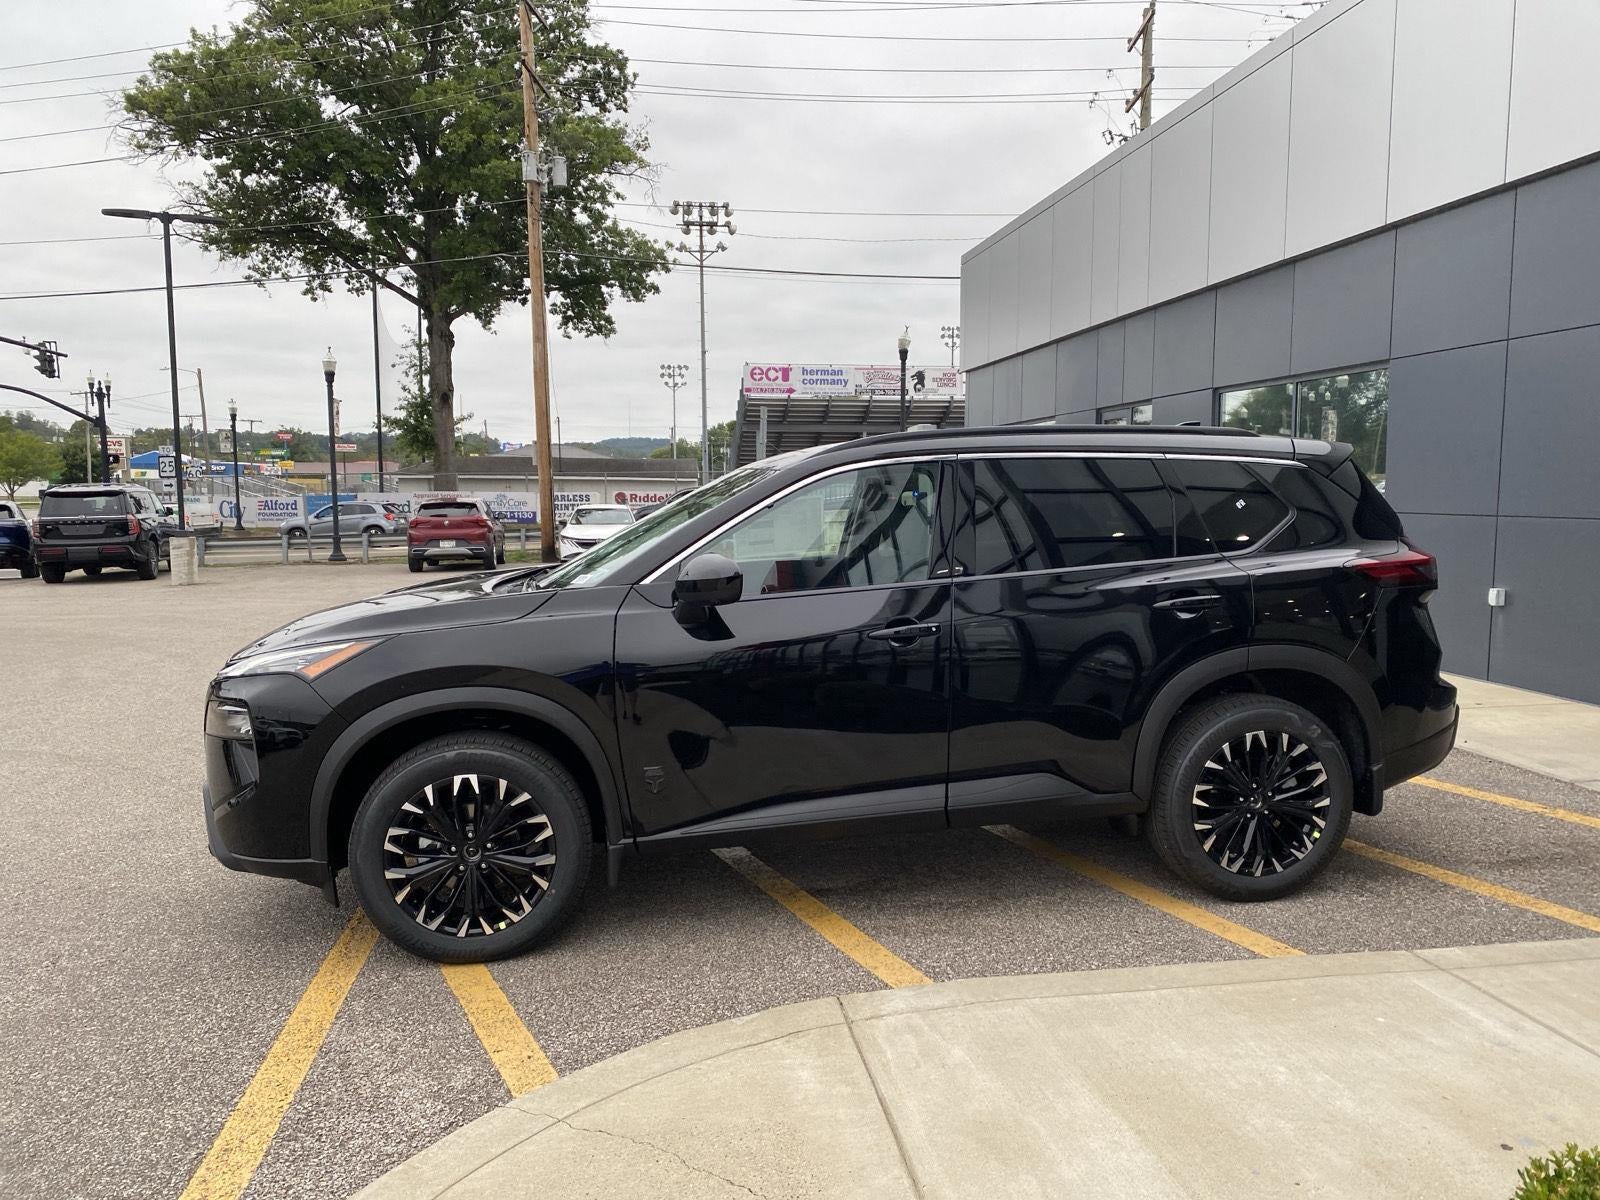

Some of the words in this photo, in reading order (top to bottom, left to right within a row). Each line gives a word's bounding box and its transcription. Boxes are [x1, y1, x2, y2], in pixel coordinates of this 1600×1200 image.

[802, 367, 842, 376] herman
[802, 377, 849, 387] cormany
[160, 460, 175, 473] 25
[187, 469, 202, 478] 60
[263, 500, 298, 510] Alford
